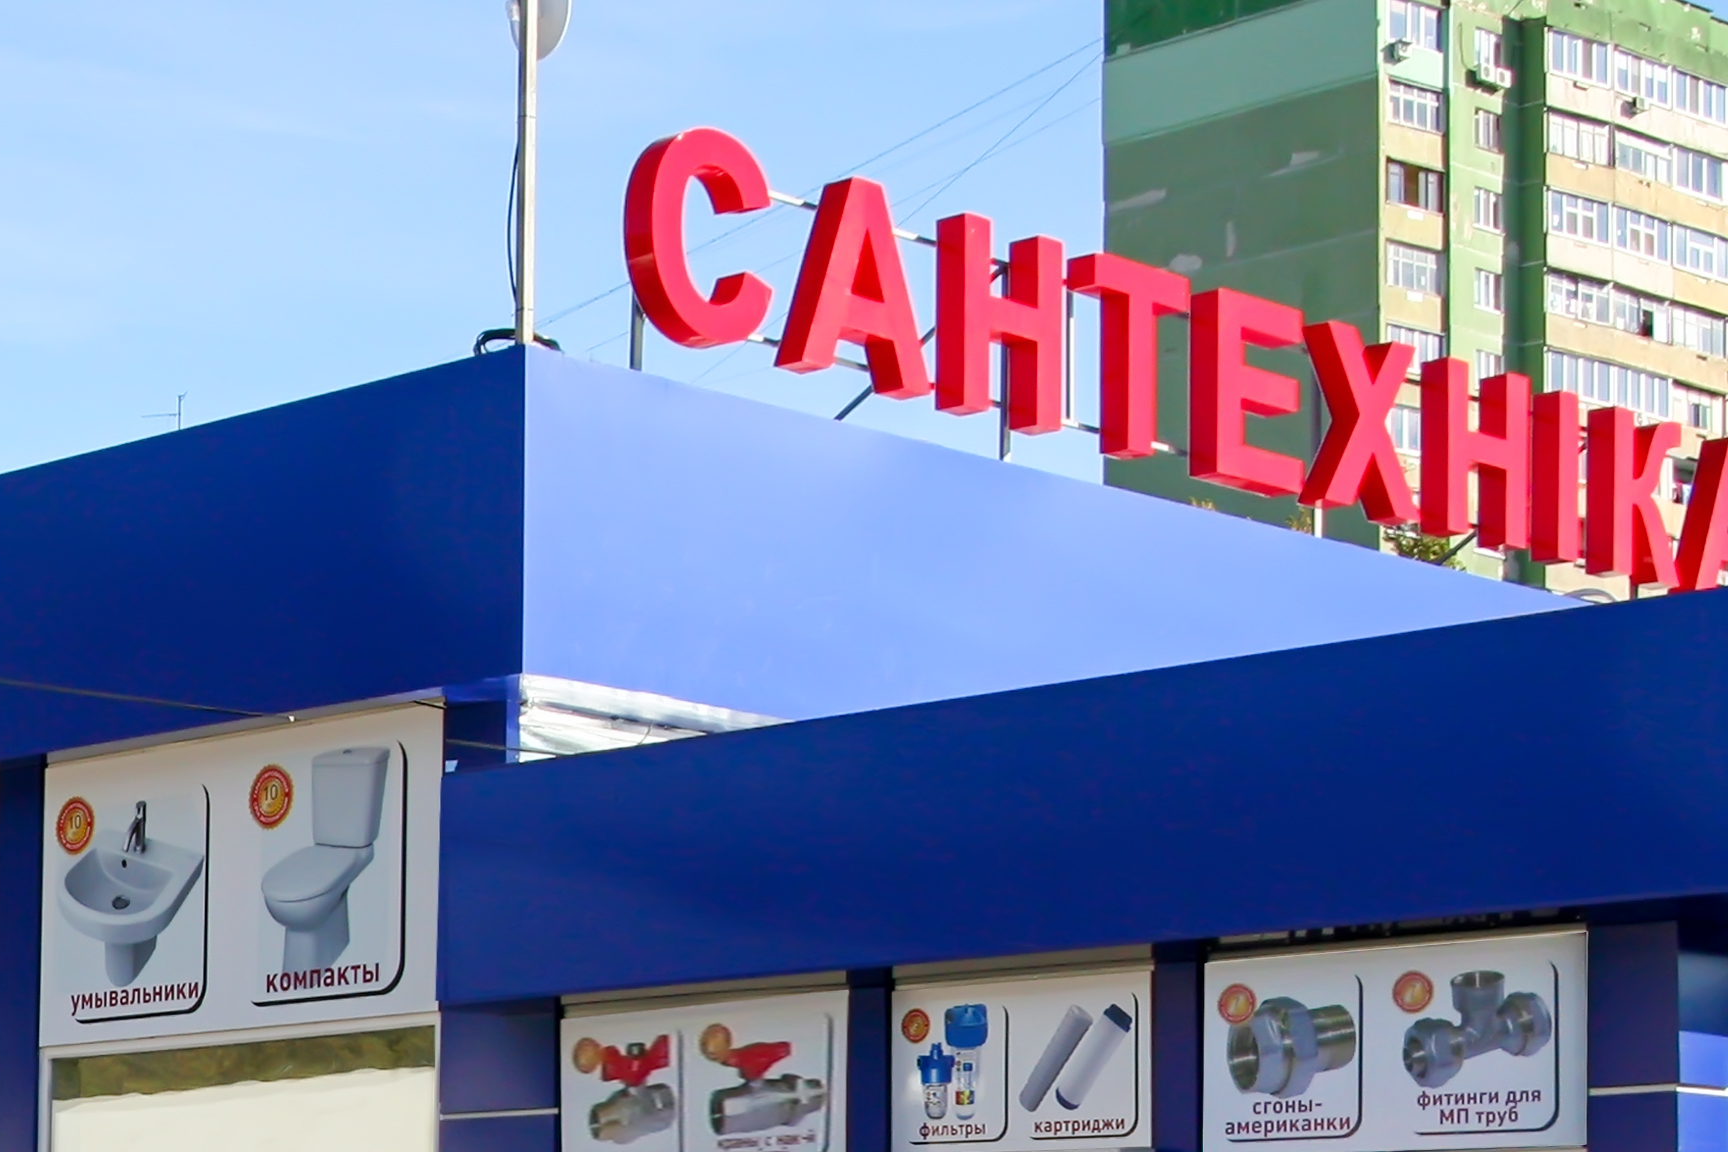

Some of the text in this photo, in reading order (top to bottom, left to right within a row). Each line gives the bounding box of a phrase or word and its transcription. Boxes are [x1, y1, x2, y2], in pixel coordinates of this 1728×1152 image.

[264, 783, 278, 802] 10
[69, 814, 81, 830] 10
[265, 963, 380, 994] компакты
[71, 981, 200, 1017] умывальники
[1252, 1098, 1323, 1116] сгоны-
[1416, 1088, 1542, 1111] фитинги для
[1034, 1117, 1126, 1136] картриджи
[1439, 1105, 1519, 1128] МП труб
[918, 1122, 986, 1140] фильтры
[1225, 1116, 1351, 1139] американки
